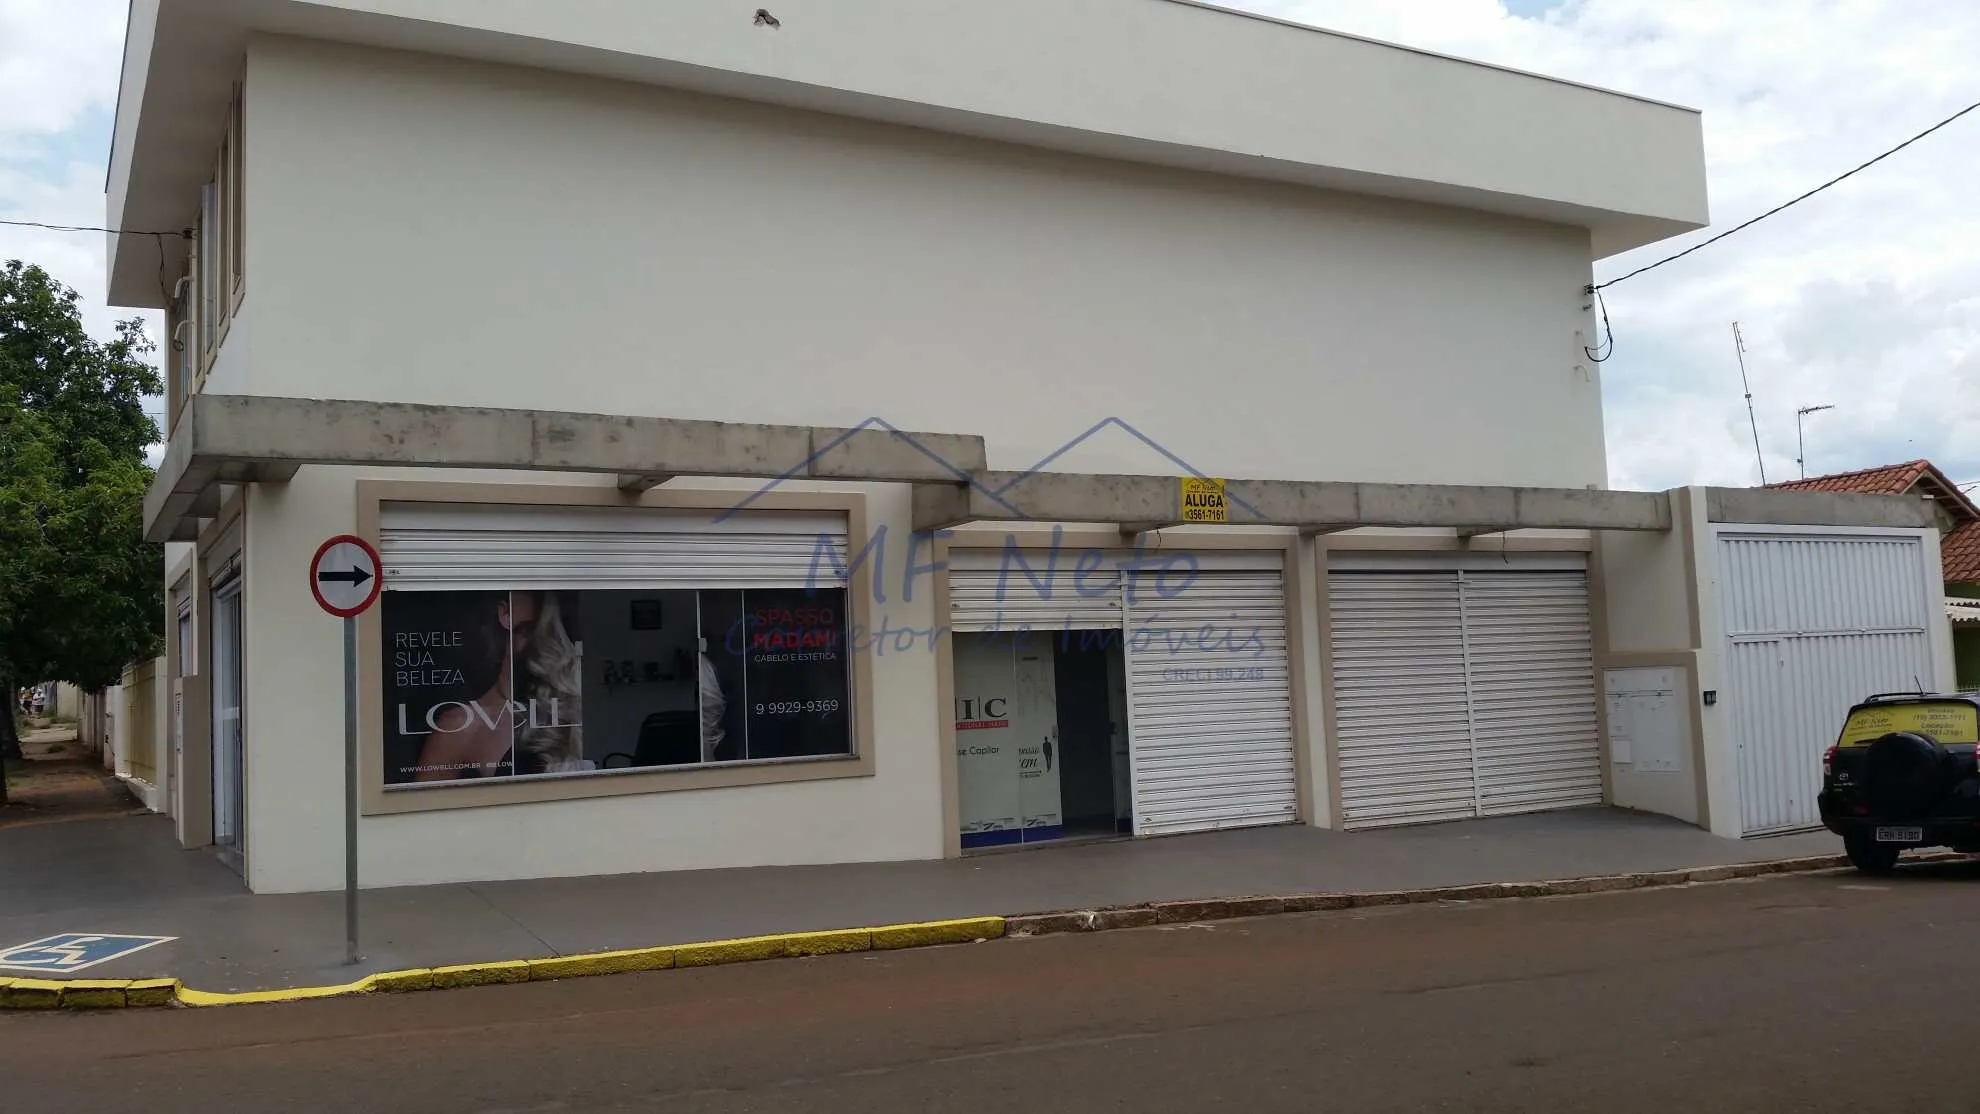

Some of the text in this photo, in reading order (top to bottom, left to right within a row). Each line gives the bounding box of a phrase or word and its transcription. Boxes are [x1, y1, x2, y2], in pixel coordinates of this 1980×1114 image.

[1185, 494, 1223, 508] ALUGA
[756, 607, 834, 626] SPASSO
[395, 631, 463, 648] REVELE
[395, 651, 434, 667] SUA
[755, 654, 788, 662] CABELO
[396, 669, 465, 687] BELEZA
[756, 699, 839, 715] 9 9929-9369
